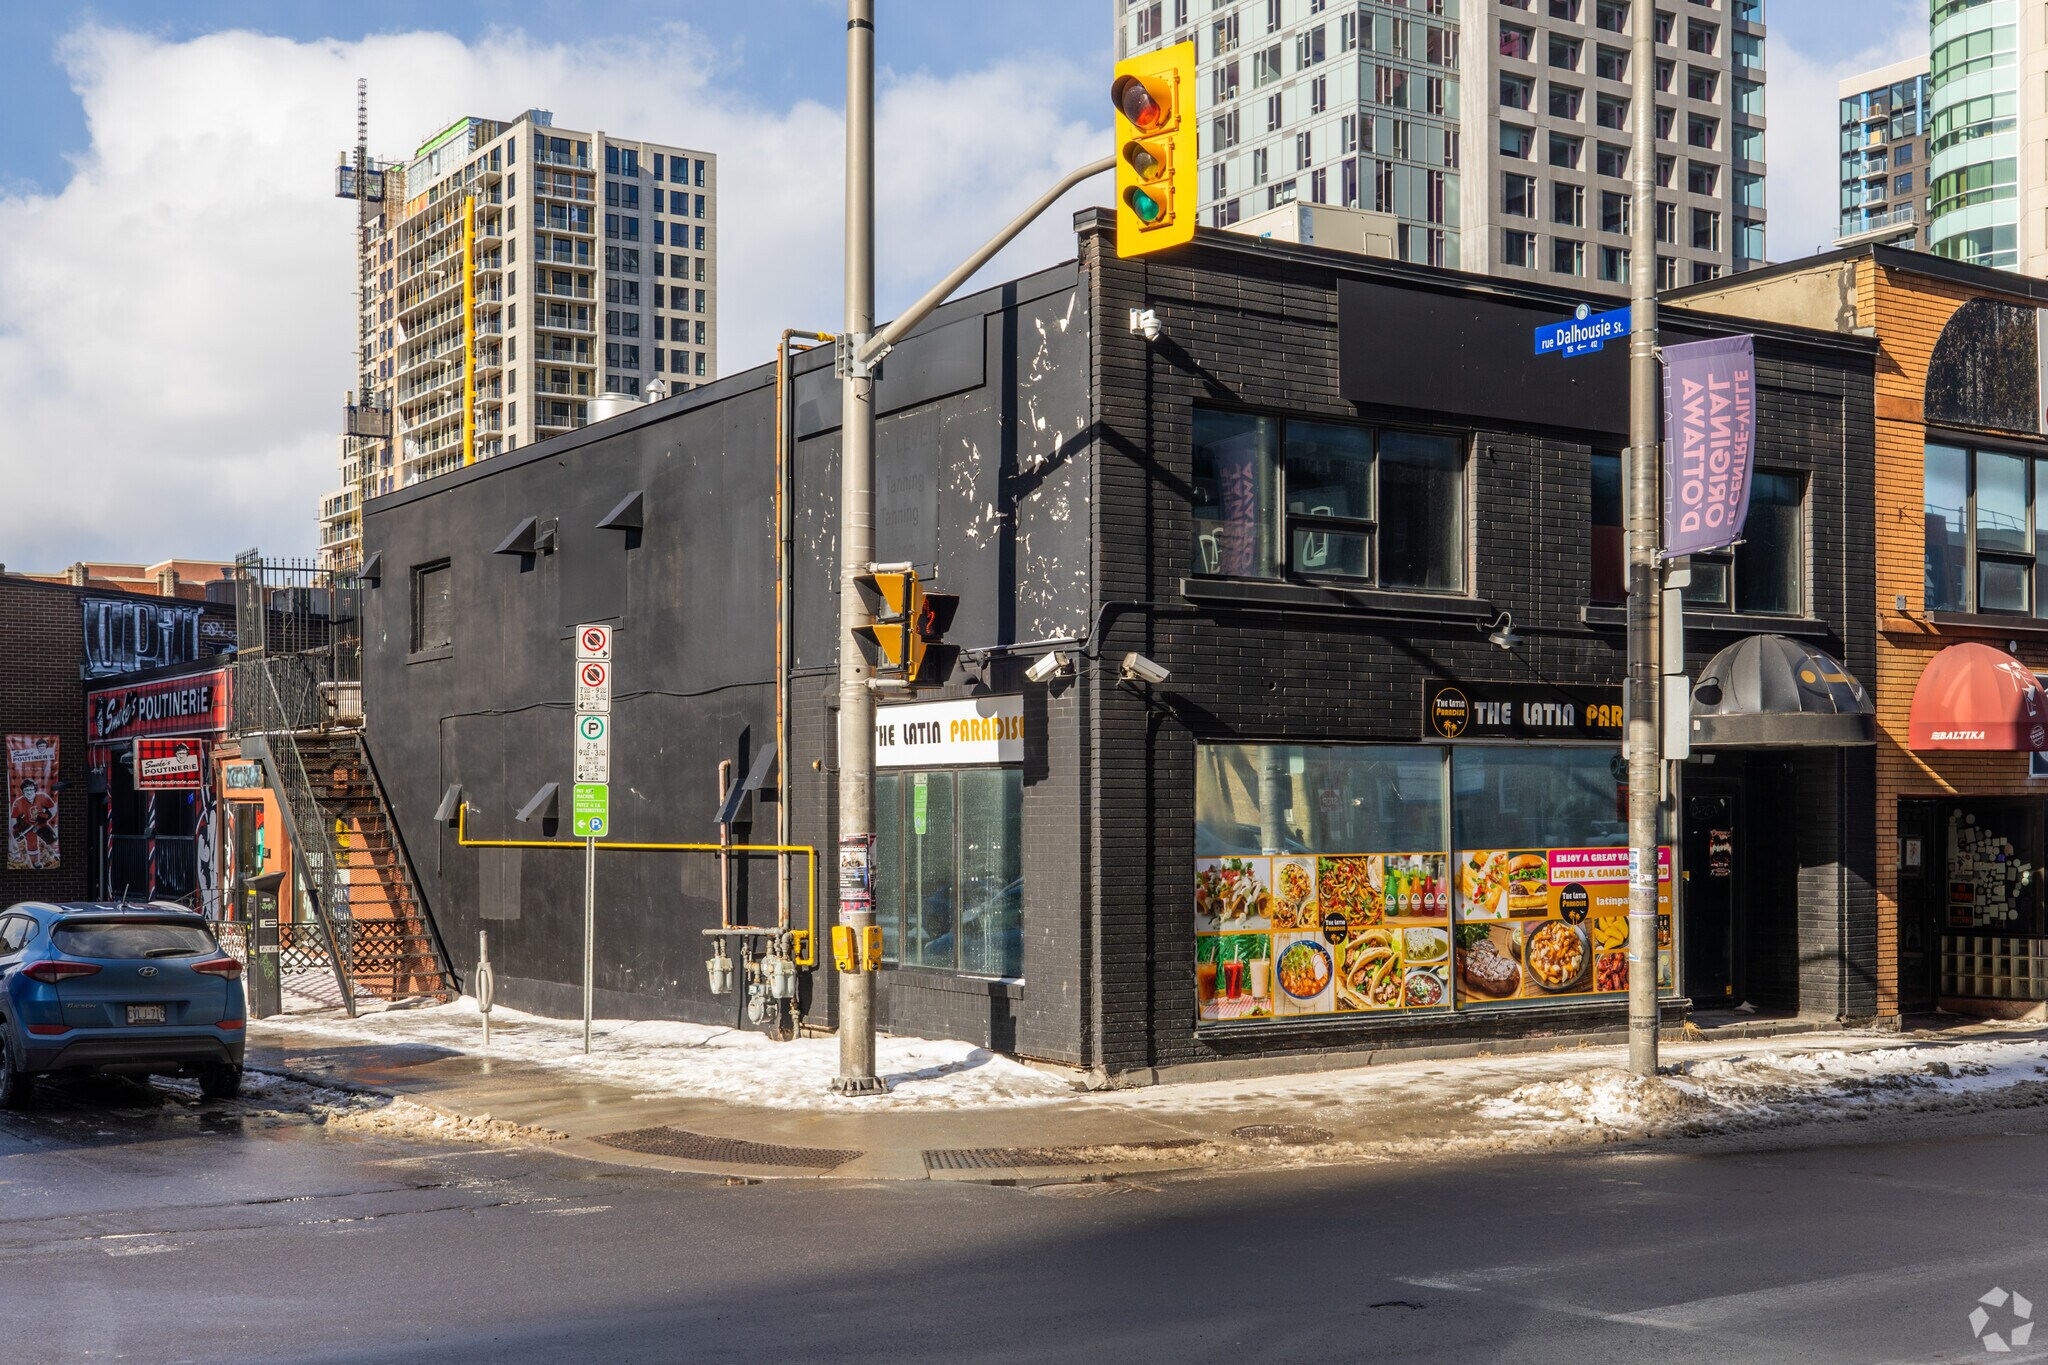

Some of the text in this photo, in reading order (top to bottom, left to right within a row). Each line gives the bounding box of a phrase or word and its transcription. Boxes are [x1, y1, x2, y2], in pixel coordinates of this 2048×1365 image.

[1541, 338, 1554, 350] rue
[1556, 318, 1611, 346] Dalhousie
[886, 473, 925, 495] Tanning
[1474, 701, 1512, 726] THE
[1522, 702, 1575, 727] LATIN
[876, 724, 895, 747] HE
[903, 720, 942, 745] LATIN
[1939, 731, 1985, 740] BALTIKA
[1556, 854, 1581, 863] ENJOY
[1582, 854, 1589, 862] A
[1590, 853, 1617, 862] GREAT
[1553, 869, 1586, 879] LATINO
[1587, 869, 1594, 878] &
